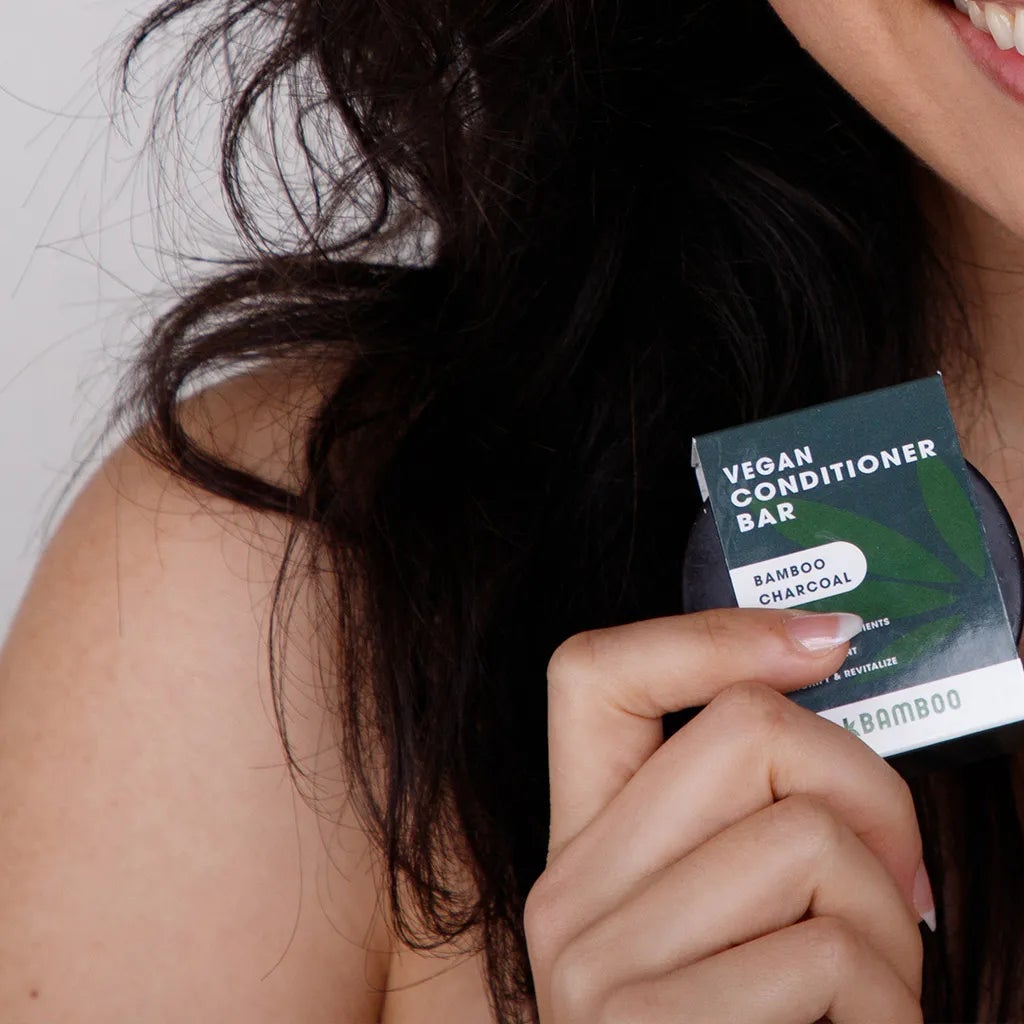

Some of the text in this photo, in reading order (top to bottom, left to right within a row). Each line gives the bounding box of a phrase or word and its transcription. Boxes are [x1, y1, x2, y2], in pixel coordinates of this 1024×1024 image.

[722, 446, 813, 484] VEGAN
[731, 439, 937, 508] CONDITIONER
[736, 502, 796, 533] BAR
[754, 558, 825, 587] BAMBOO
[759, 572, 852, 605] CHARCOAL
[833, 656, 898, 681] & REVITALIZE
